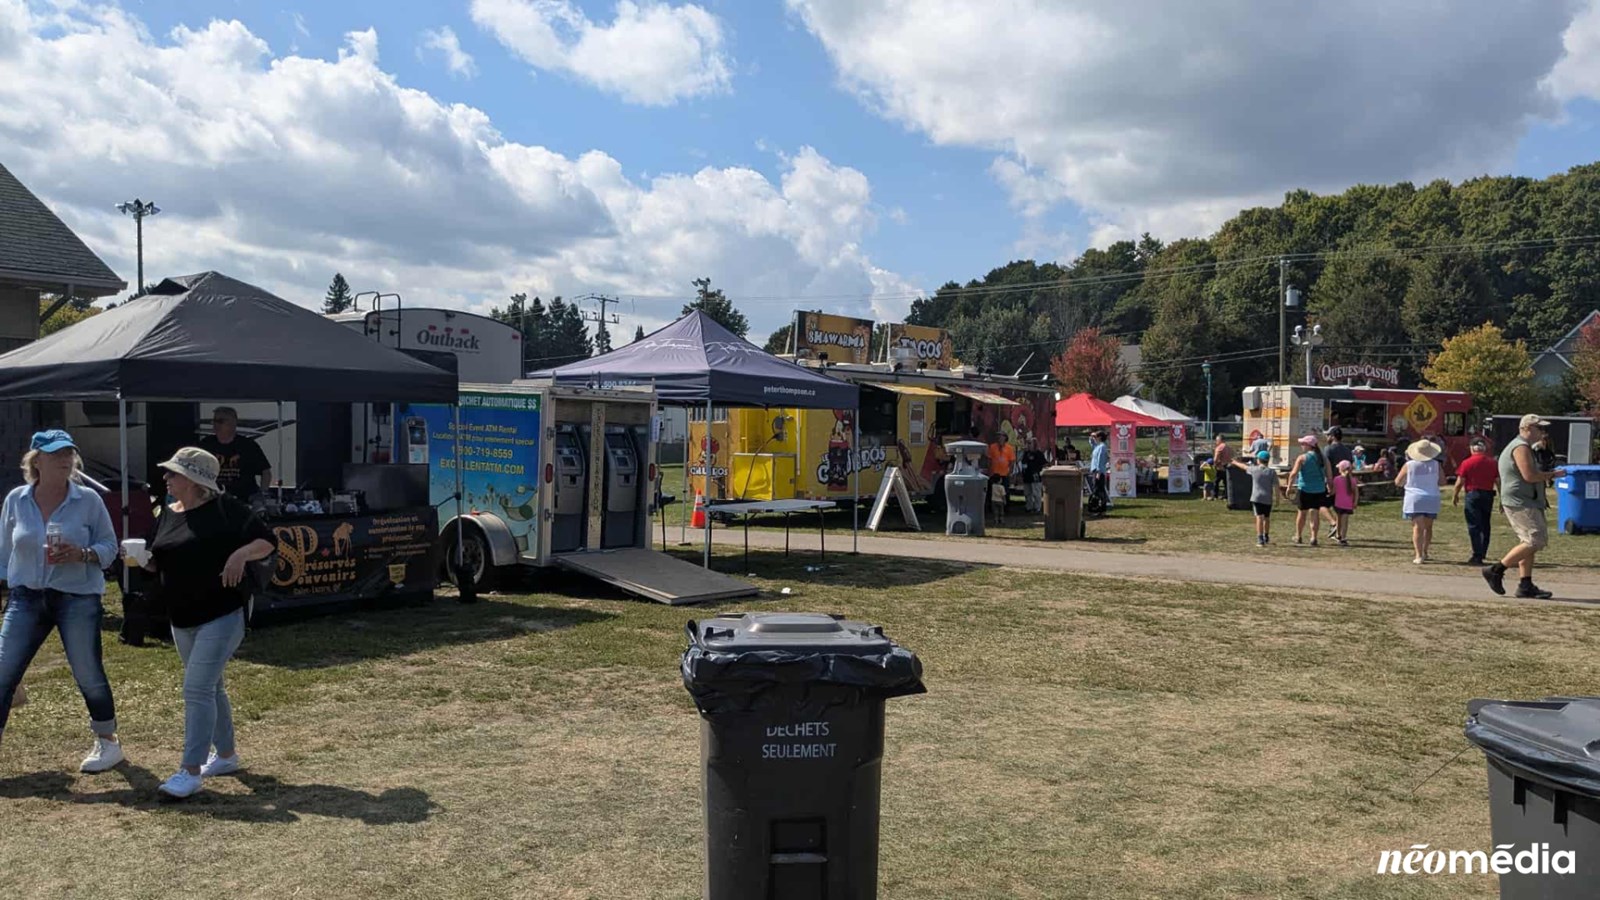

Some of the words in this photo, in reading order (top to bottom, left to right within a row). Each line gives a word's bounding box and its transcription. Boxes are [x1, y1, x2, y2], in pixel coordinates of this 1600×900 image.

[417, 329, 480, 350] Outback
[808, 330, 865, 348] SHAWARMA
[762, 743, 837, 759] SEULEMENT
